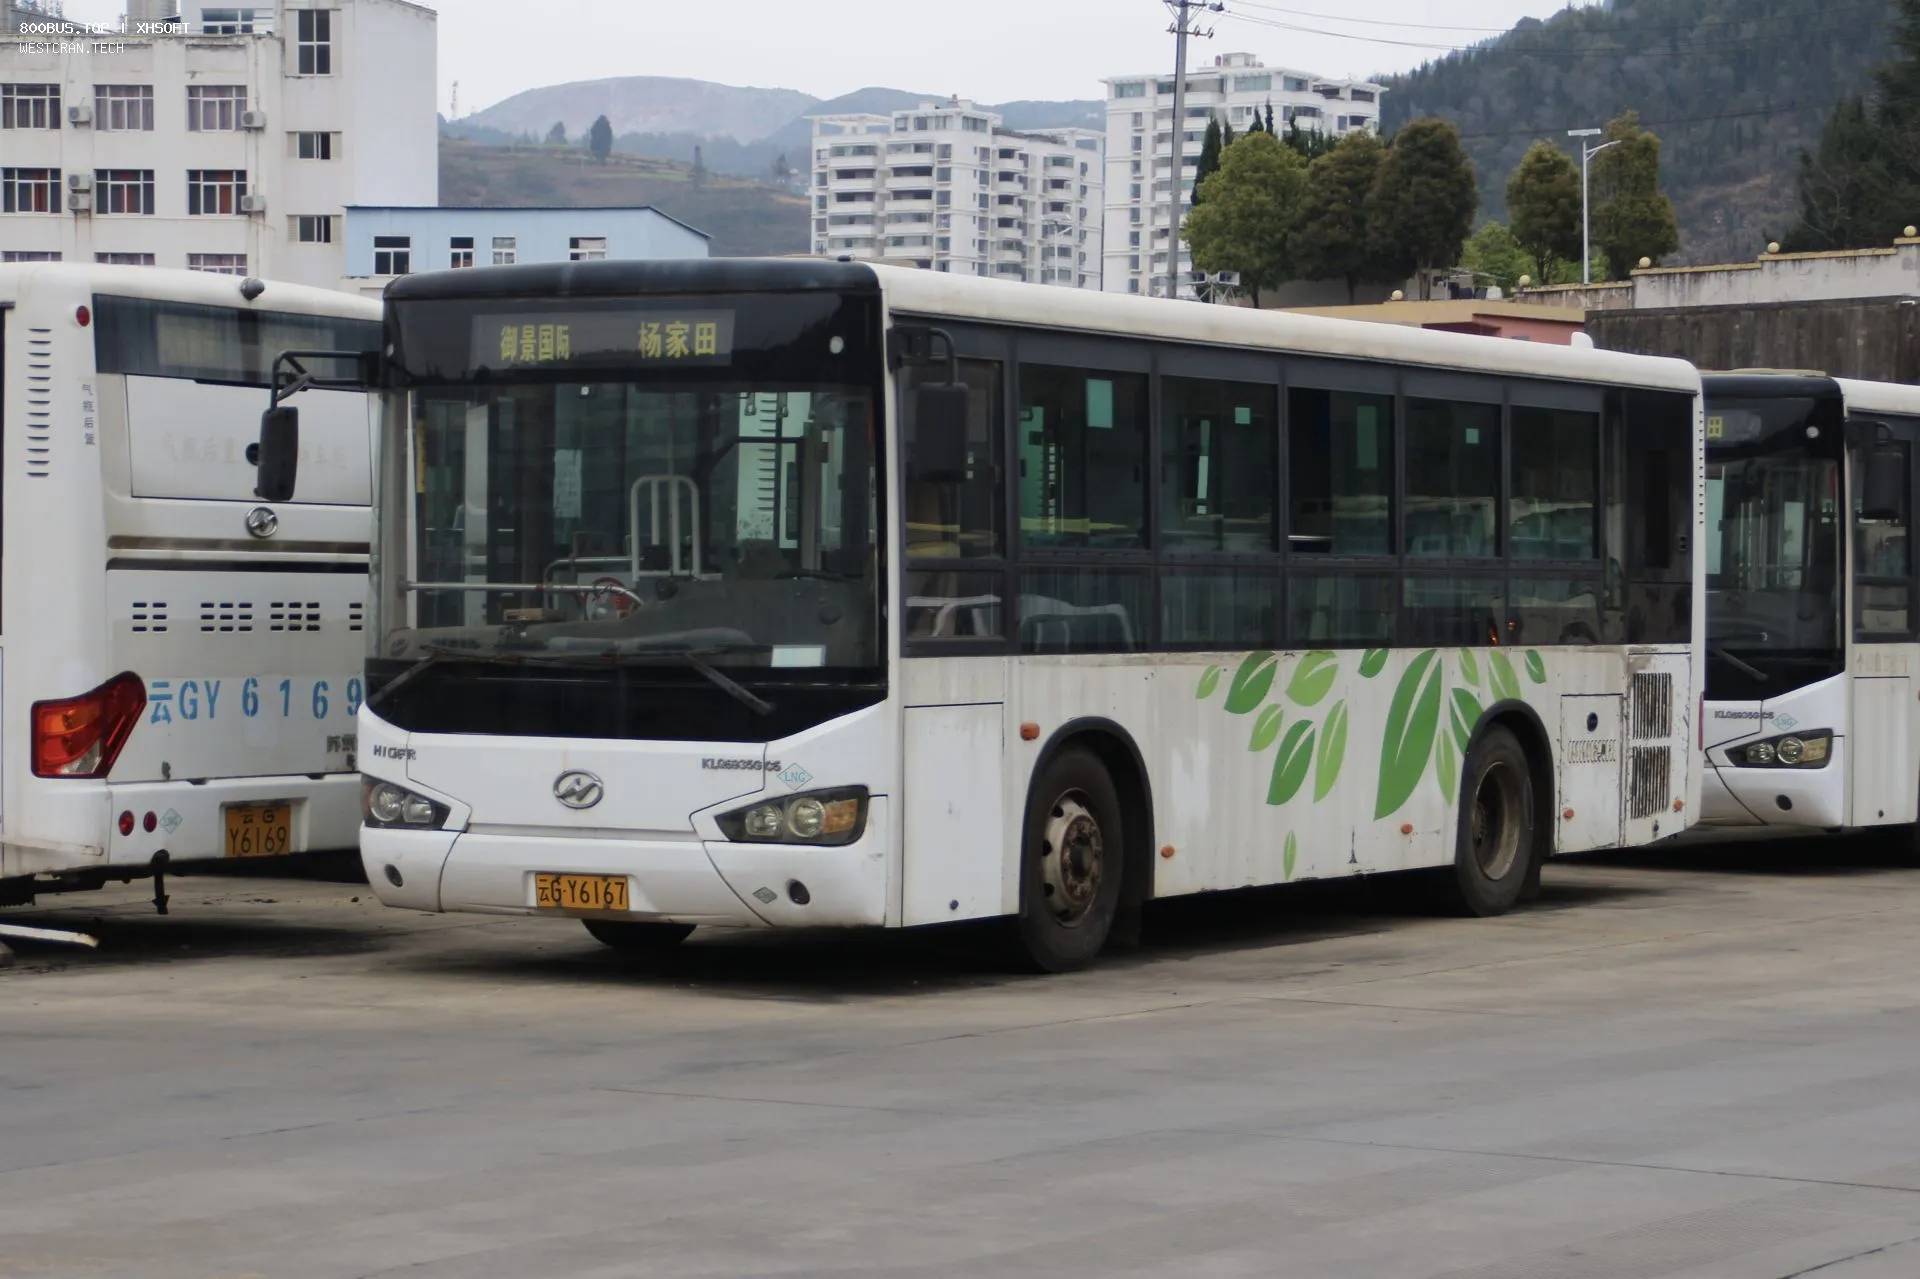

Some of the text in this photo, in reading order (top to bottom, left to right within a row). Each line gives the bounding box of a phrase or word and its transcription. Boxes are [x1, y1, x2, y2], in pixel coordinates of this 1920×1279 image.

[500, 320, 717, 361] 御景国际 杨家田
[784, 771, 806, 783] LNG
[240, 809, 276, 824] 云G
[229, 826, 288, 855] Y6169
